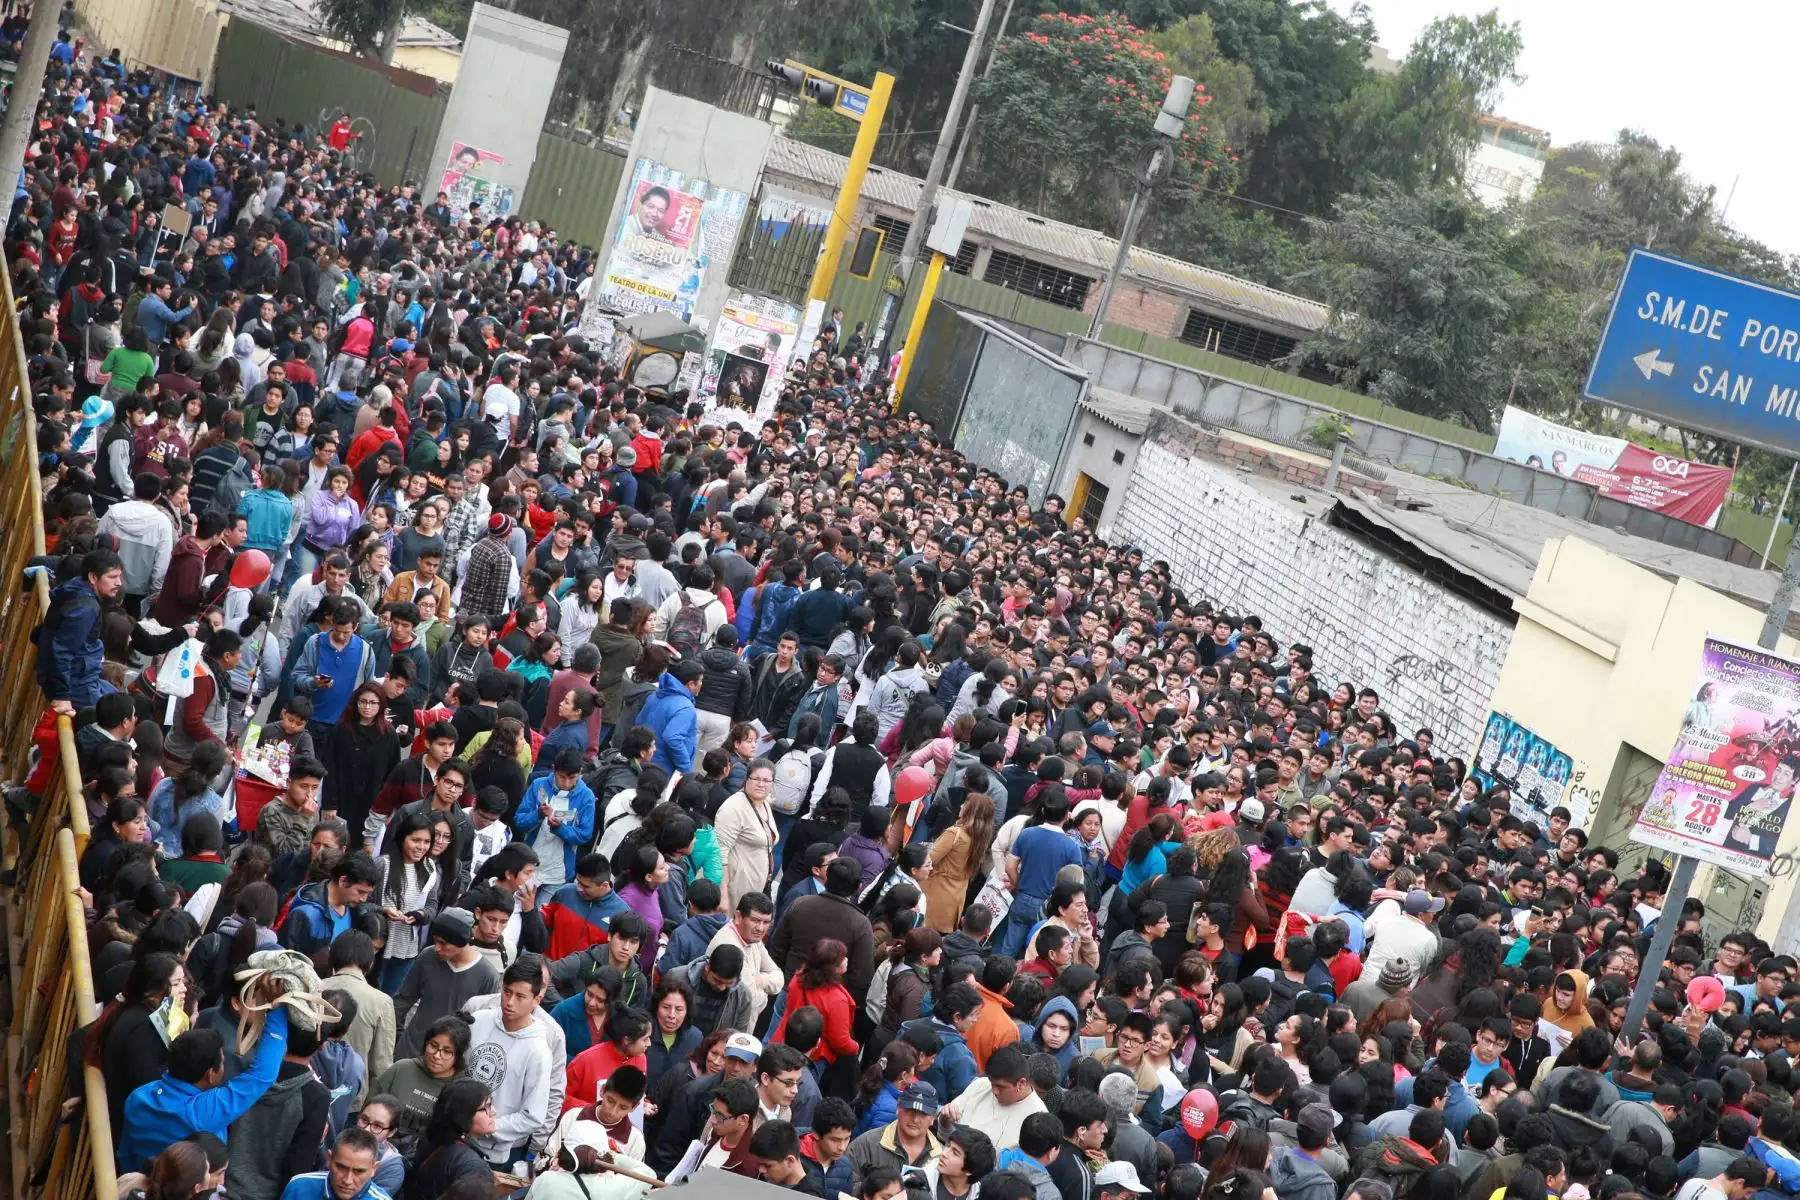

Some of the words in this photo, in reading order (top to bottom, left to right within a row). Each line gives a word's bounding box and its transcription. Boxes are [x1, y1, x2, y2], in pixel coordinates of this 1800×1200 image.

[675, 210, 693, 230] 21
[609, 275, 636, 289] TEATRO
[637, 283, 647, 292] DE
[647, 286, 657, 295] LA
[658, 290, 672, 300] UNI
[1738, 318, 1800, 362] POR
[1693, 365, 1753, 405] SAN
[1540, 428, 1564, 444] SAN
[1565, 436, 1616, 457] MARCOS
[1652, 455, 1690, 479] OCA
[1710, 642, 1759, 663] HOMENAJE
[1759, 656, 1766, 664] A
[1767, 658, 1791, 672] JUAN
[1704, 667, 1743, 684] Mariachi
[1723, 660, 1765, 680] Concierto
[1684, 724, 1697, 735] 25
[1666, 765, 1703, 780] COLEGIO
[1702, 774, 1737, 790] MEDICO
[1681, 759, 1728, 777] AUDITORIO
[1741, 769, 1757, 779] 38
[1696, 792, 1723, 805] MARTES
[1685, 799, 1722, 828] 28
[1684, 820, 1712, 834] AGOSTO
[477, 1046, 504, 1067] QUIKSILVER
